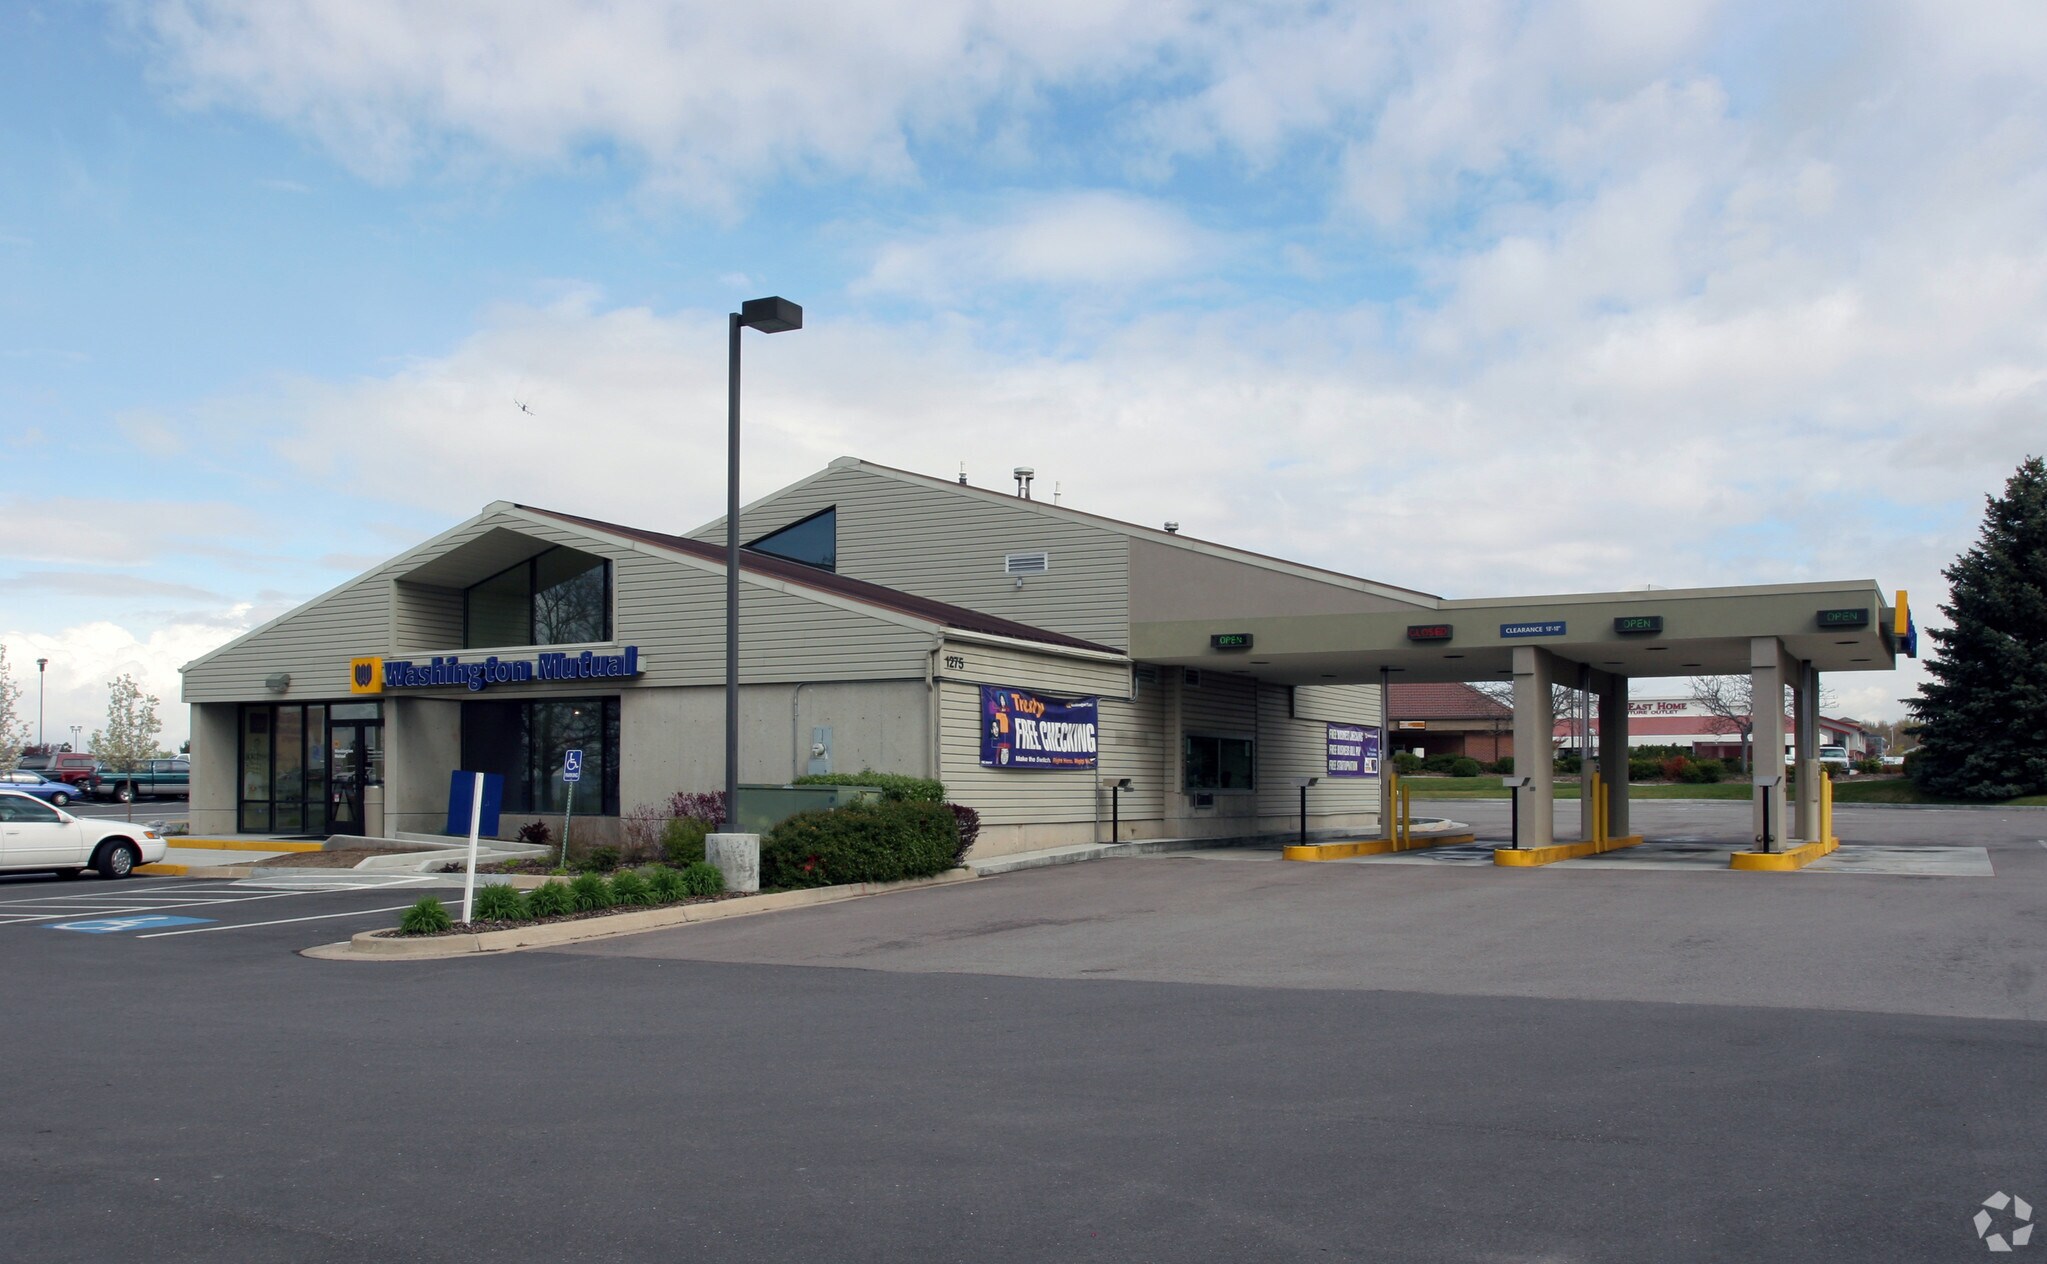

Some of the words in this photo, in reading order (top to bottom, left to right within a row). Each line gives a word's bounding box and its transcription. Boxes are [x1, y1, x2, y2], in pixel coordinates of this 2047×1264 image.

[1827, 611, 1858, 621] OPEN
[1623, 618, 1651, 628] OPEN
[1408, 627, 1448, 637] CLOSED
[1505, 626, 1543, 634] CLEARANCE
[1220, 636, 1243, 644] OPEN
[944, 655, 964, 670] 1275
[384, 656, 532, 692] Washington
[537, 645, 638, 680] Mutual
[1657, 701, 1687, 710] HOME
[1014, 717, 1042, 751] FREE
[1039, 721, 1096, 752] CHECKING
